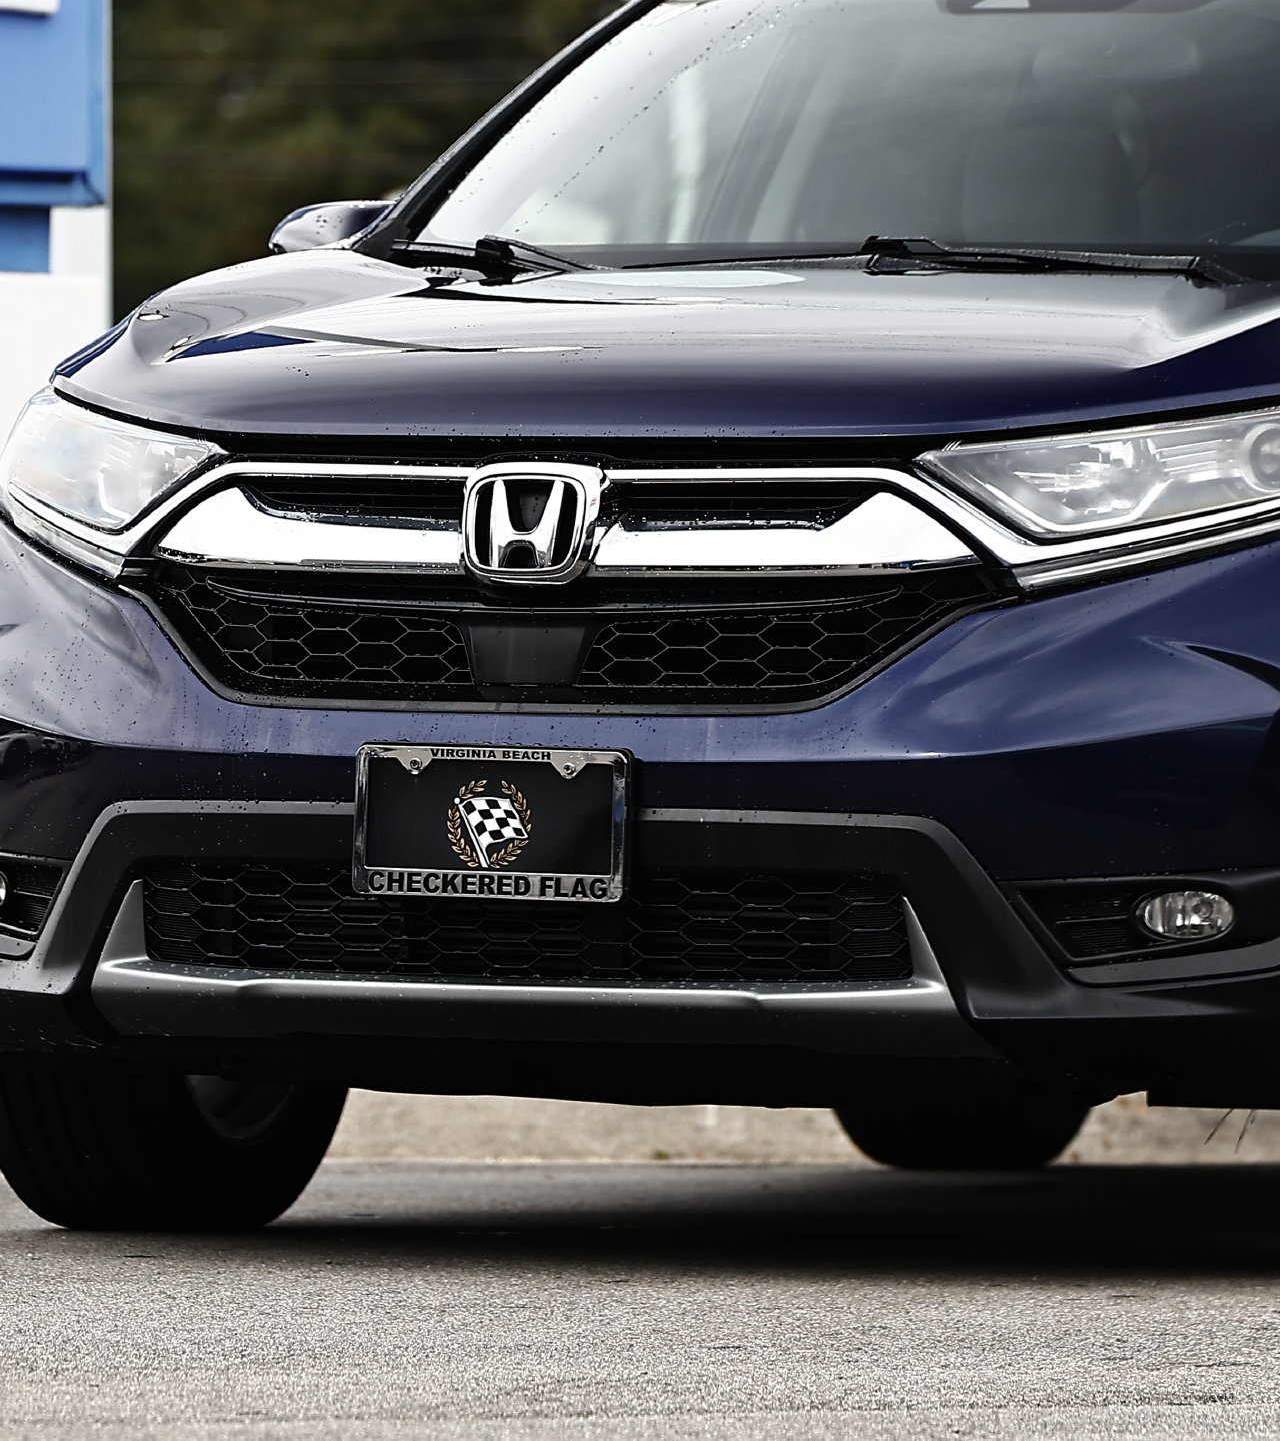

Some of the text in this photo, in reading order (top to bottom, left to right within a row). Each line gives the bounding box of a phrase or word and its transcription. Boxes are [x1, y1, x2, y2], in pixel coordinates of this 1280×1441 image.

[430, 748, 551, 761] VIRGINIA BEACH
[369, 871, 608, 900] CHECKERED FLAG
